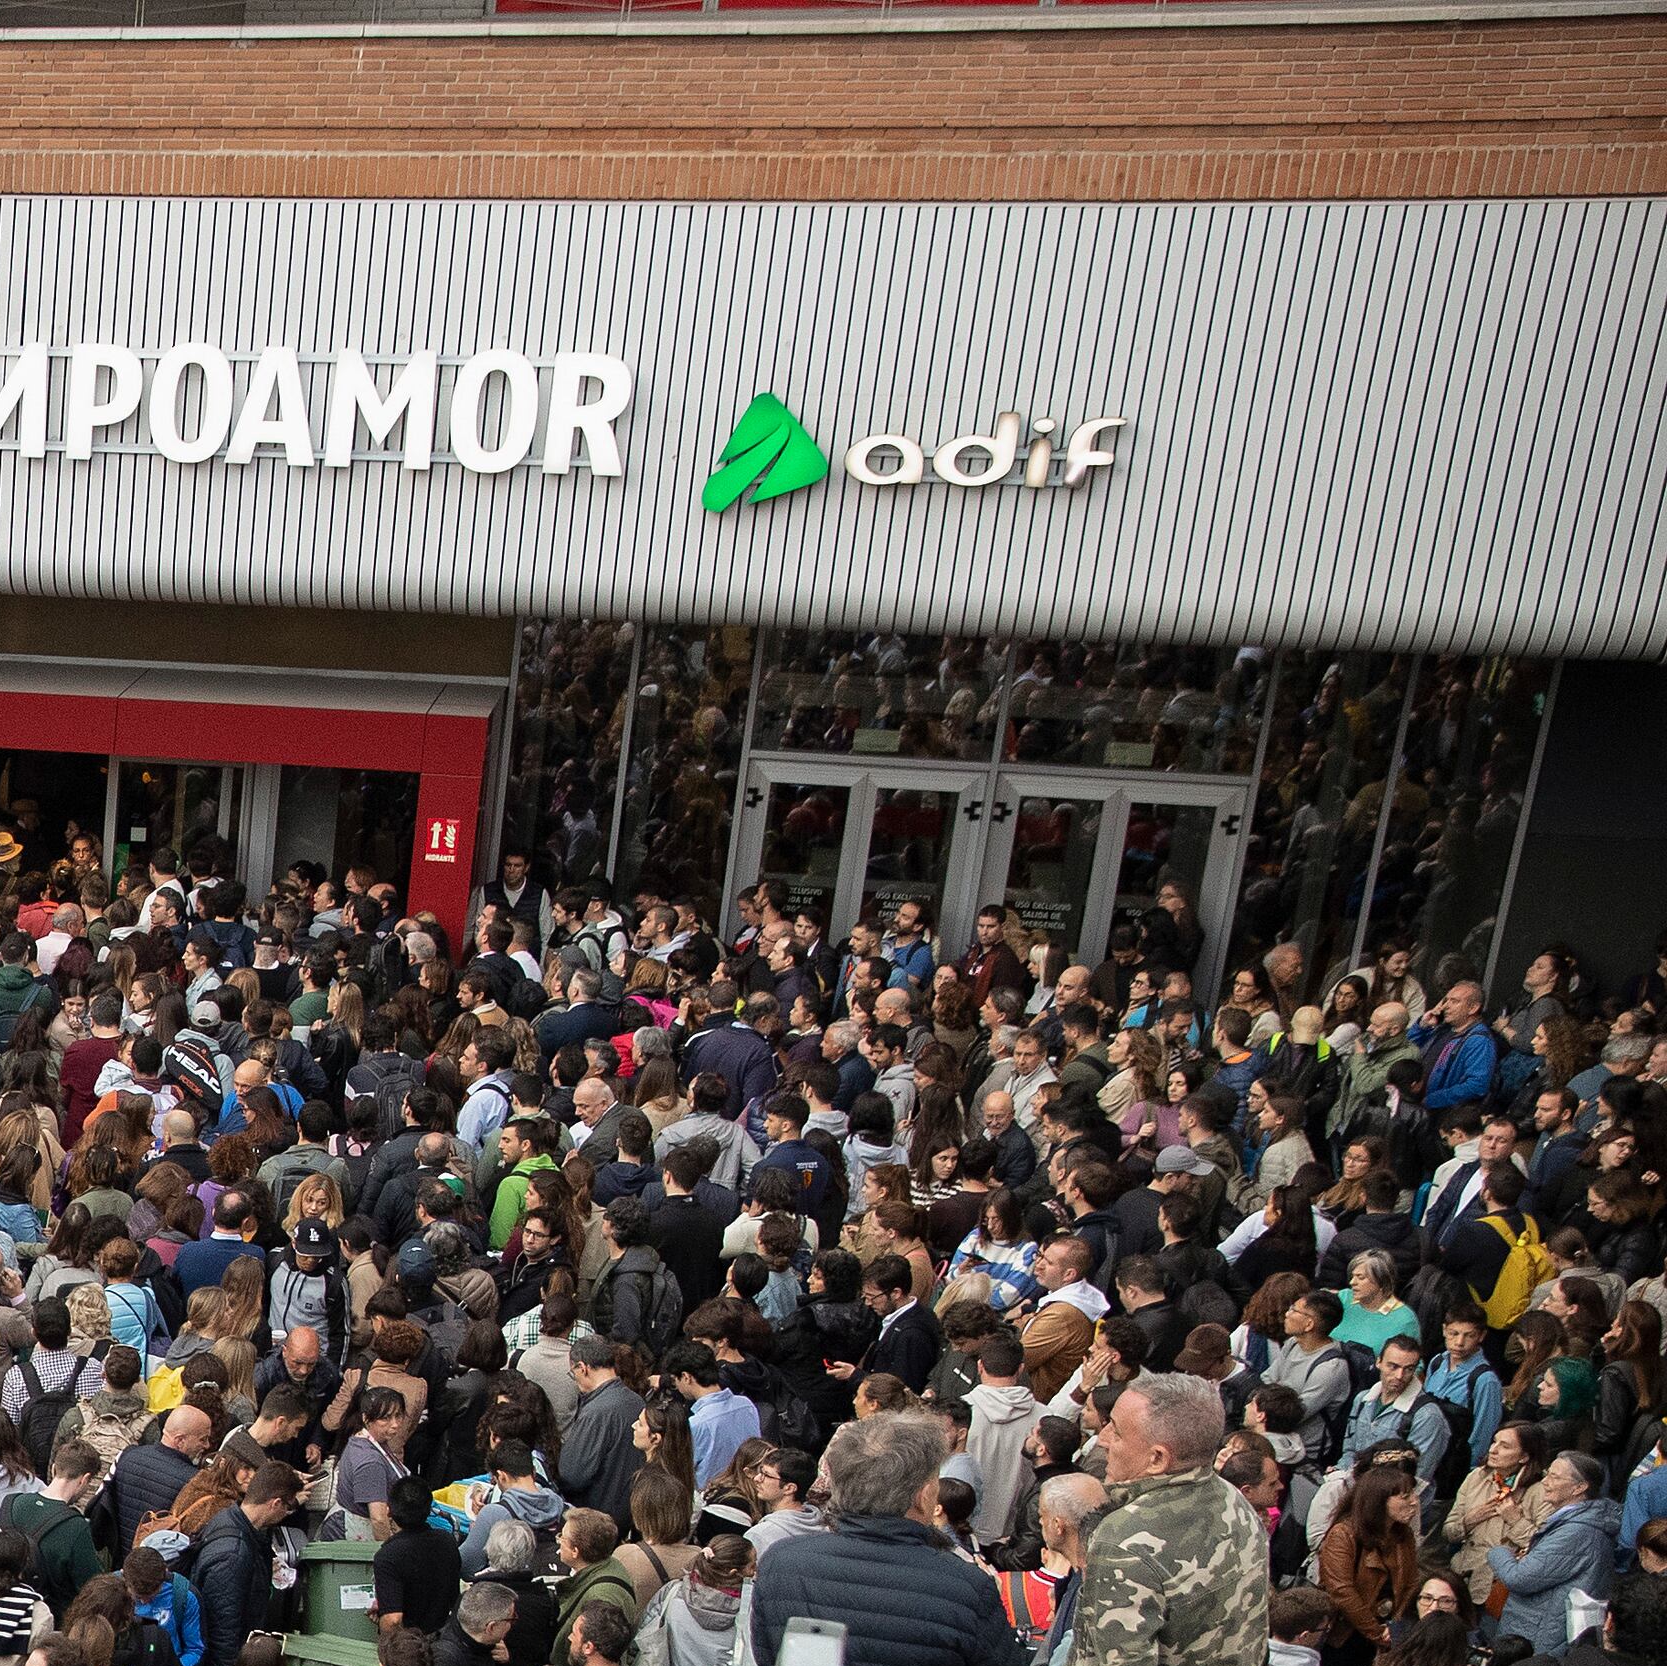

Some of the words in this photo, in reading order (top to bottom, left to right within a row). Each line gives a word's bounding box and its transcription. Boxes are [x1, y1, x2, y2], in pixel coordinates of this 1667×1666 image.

[844, 411, 1128, 487] adif
[425, 853, 456, 863] HIDRANTE
[875, 891, 891, 900] USO
[1014, 900, 1030, 909] USO
[1031, 901, 1072, 912] EXCLUSIVO
[1021, 910, 1049, 920] SALIDA
[1050, 911, 1061, 920] DE
